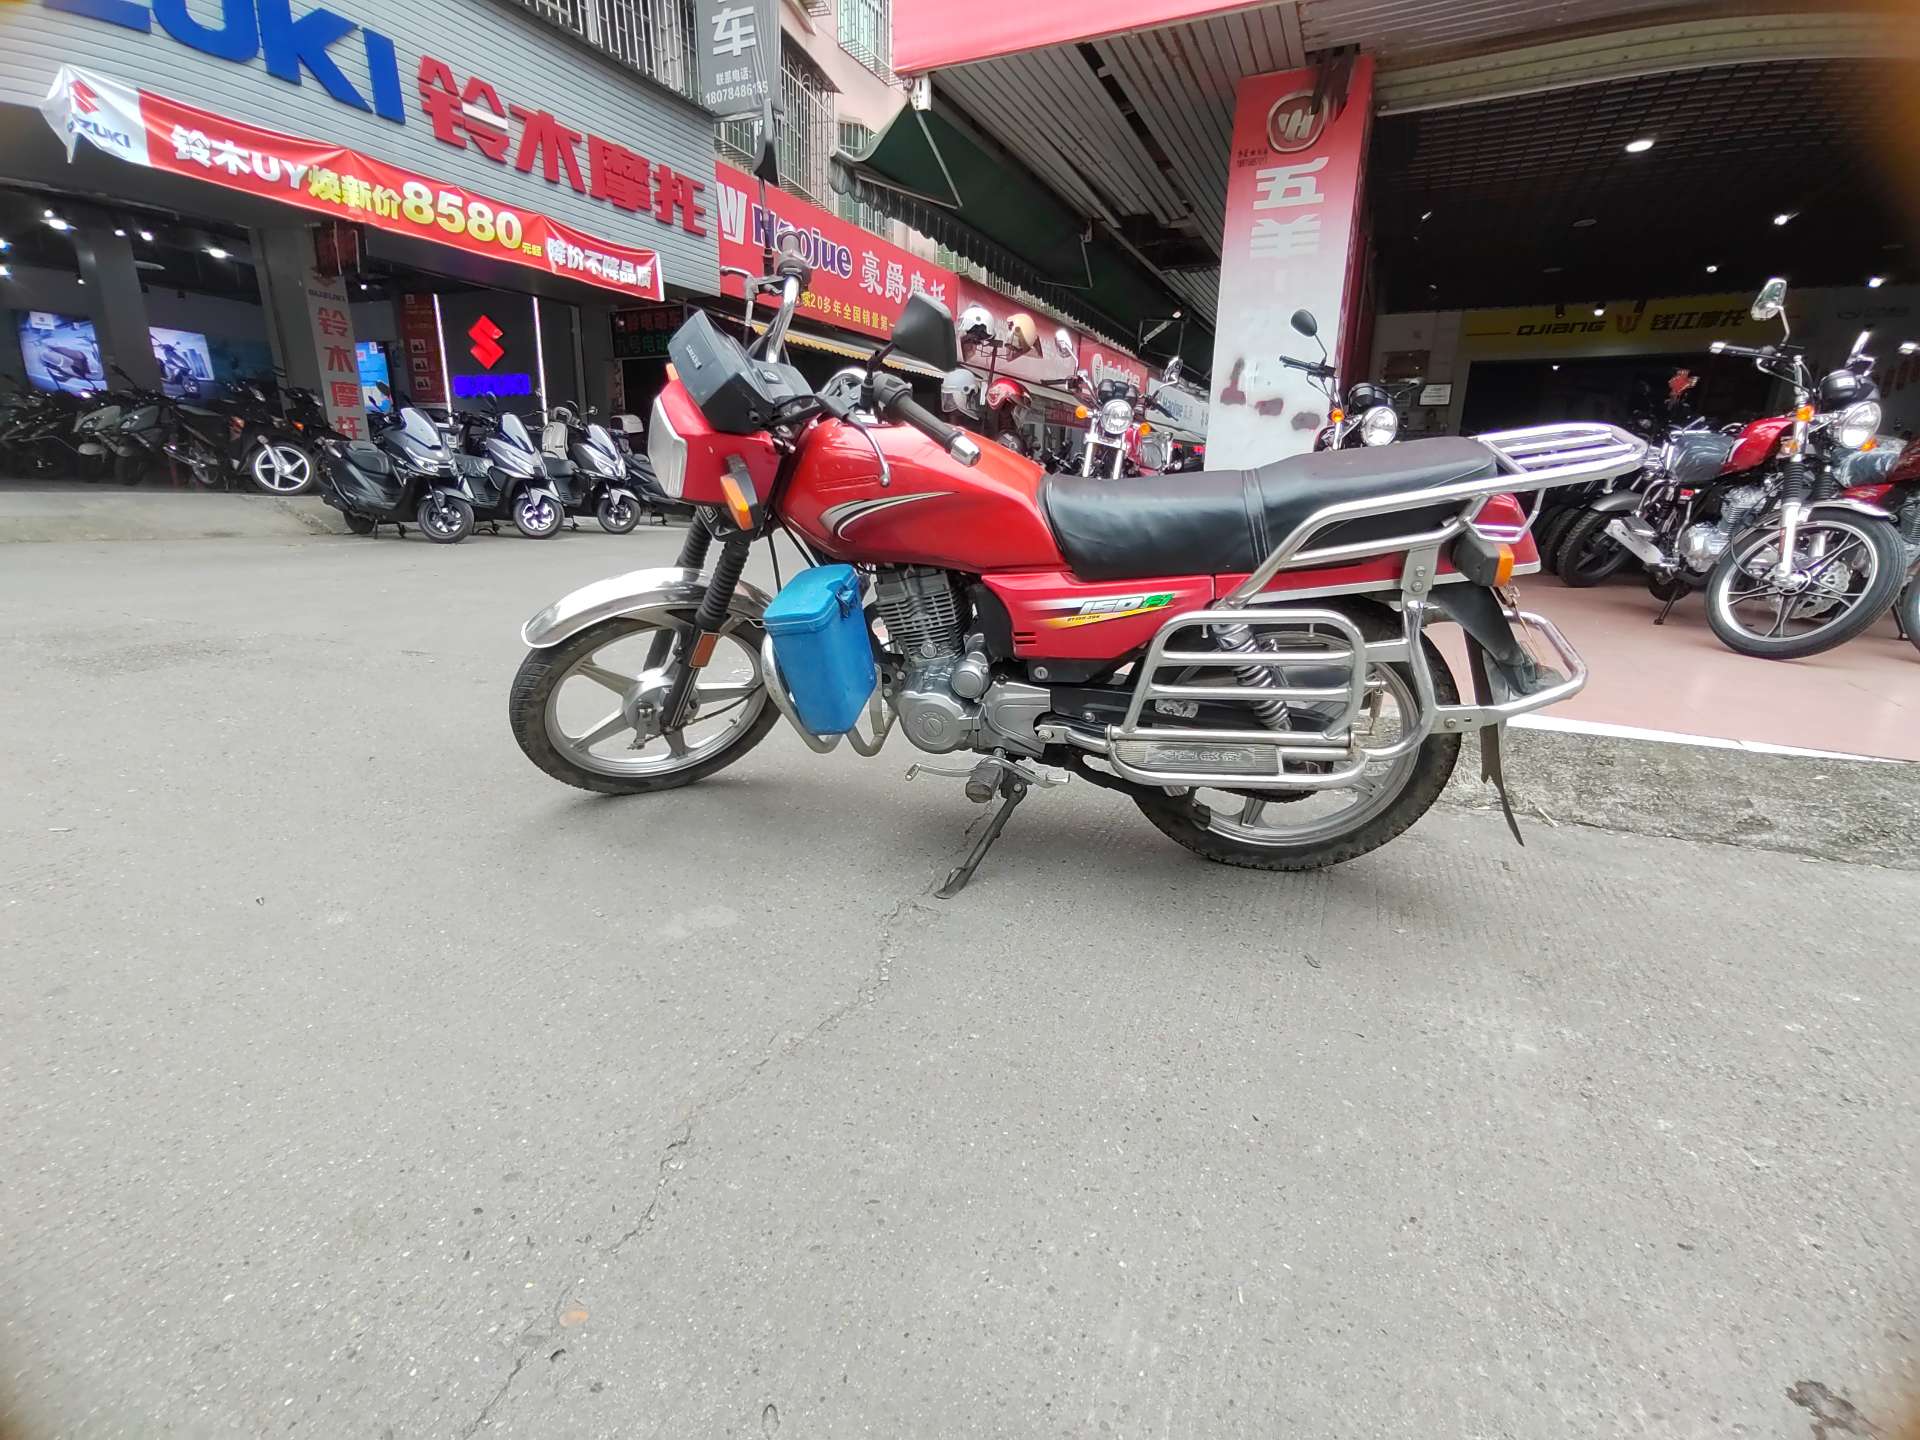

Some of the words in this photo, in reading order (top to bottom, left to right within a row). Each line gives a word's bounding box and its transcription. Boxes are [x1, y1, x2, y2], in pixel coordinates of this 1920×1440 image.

[712, 0, 756, 57] 车
[67, 118, 131, 148] ZUKI
[418, 54, 706, 237] 铃木摩托
[1250, 157, 1329, 258] 五羊
[859, 250, 946, 304] 豪爵摩托
[796, 291, 896, 331] 续20多年全国销量第一
[316, 305, 362, 441] 铃木摩托
